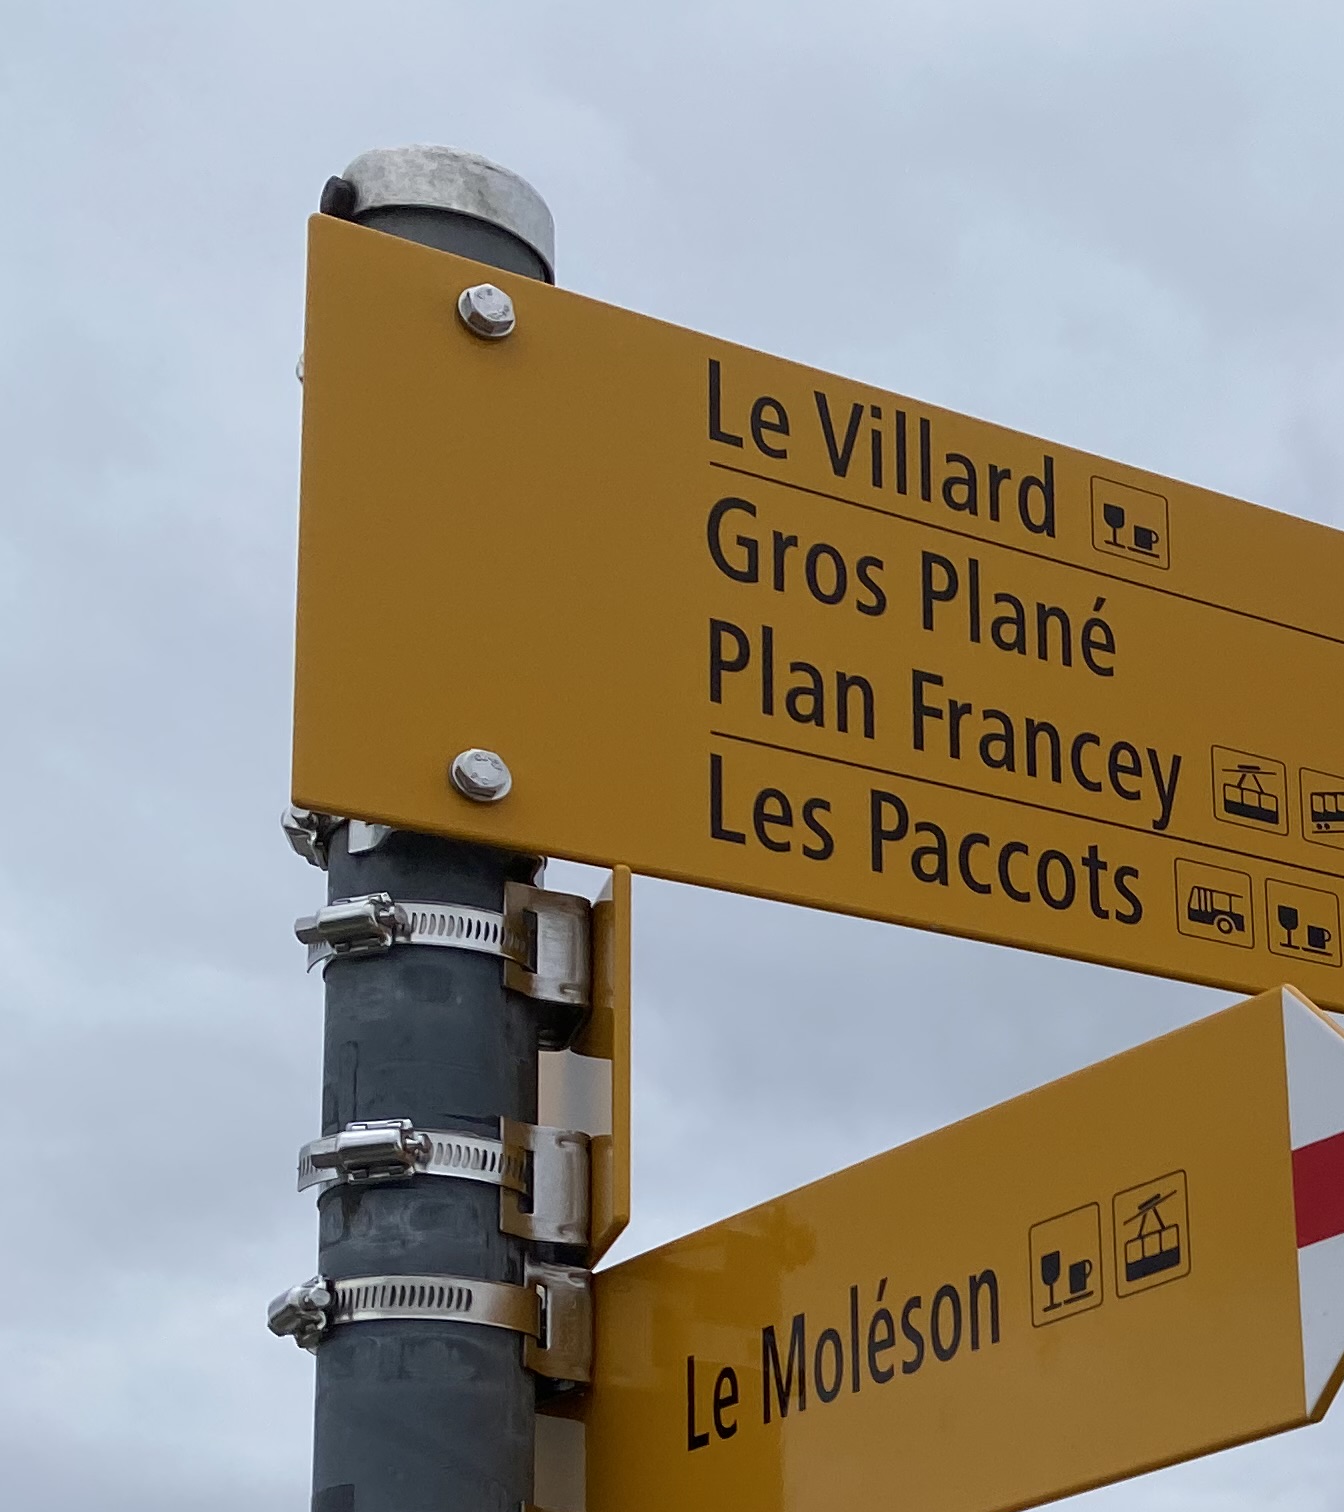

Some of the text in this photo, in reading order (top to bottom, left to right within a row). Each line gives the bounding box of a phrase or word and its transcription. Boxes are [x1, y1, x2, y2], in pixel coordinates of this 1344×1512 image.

[708, 357, 1057, 540] Le Villard
[706, 496, 1117, 678] Gros Plané
[708, 617, 1183, 832] Plan Francey
[709, 751, 1144, 926] Les Paccots
[686, 1268, 1000, 1453] Le Moléson
